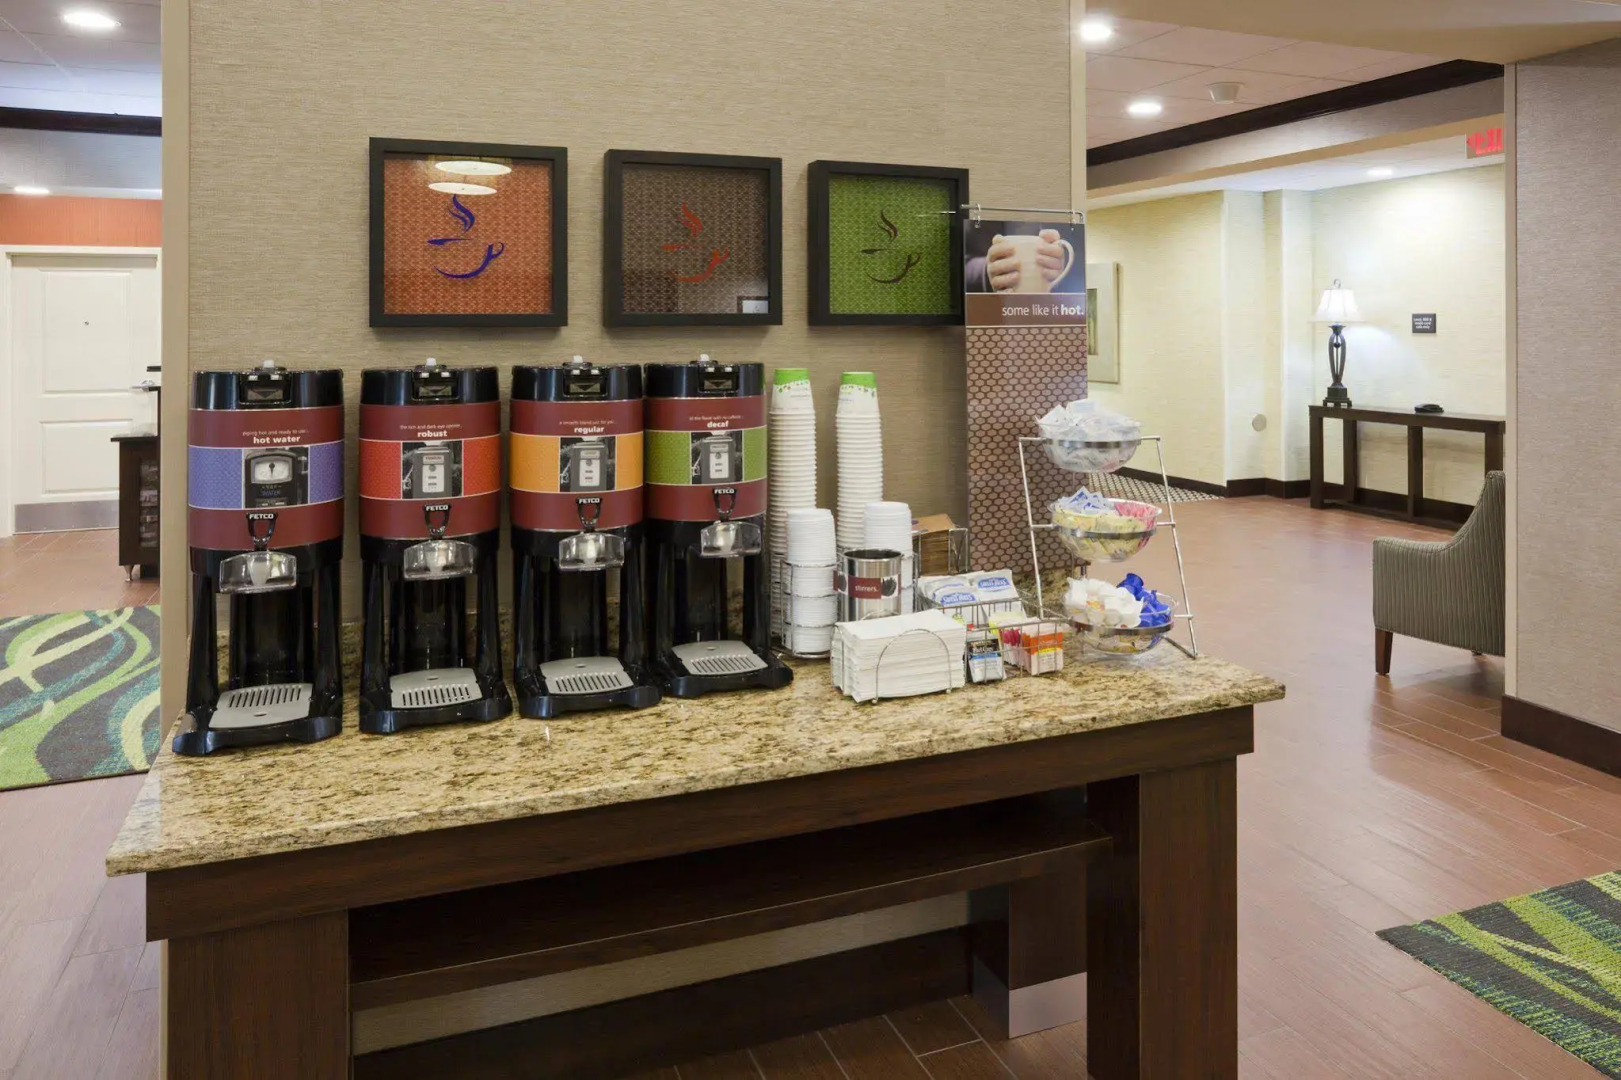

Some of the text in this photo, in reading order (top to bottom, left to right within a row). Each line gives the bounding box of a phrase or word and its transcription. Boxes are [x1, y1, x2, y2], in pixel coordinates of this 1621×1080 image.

[1475, 128, 1504, 156] EXI
[1002, 304, 1084, 316] some like it hot.
[707, 420, 729, 428] decaf
[574, 426, 604, 434] regular
[253, 436, 270, 444] hot
